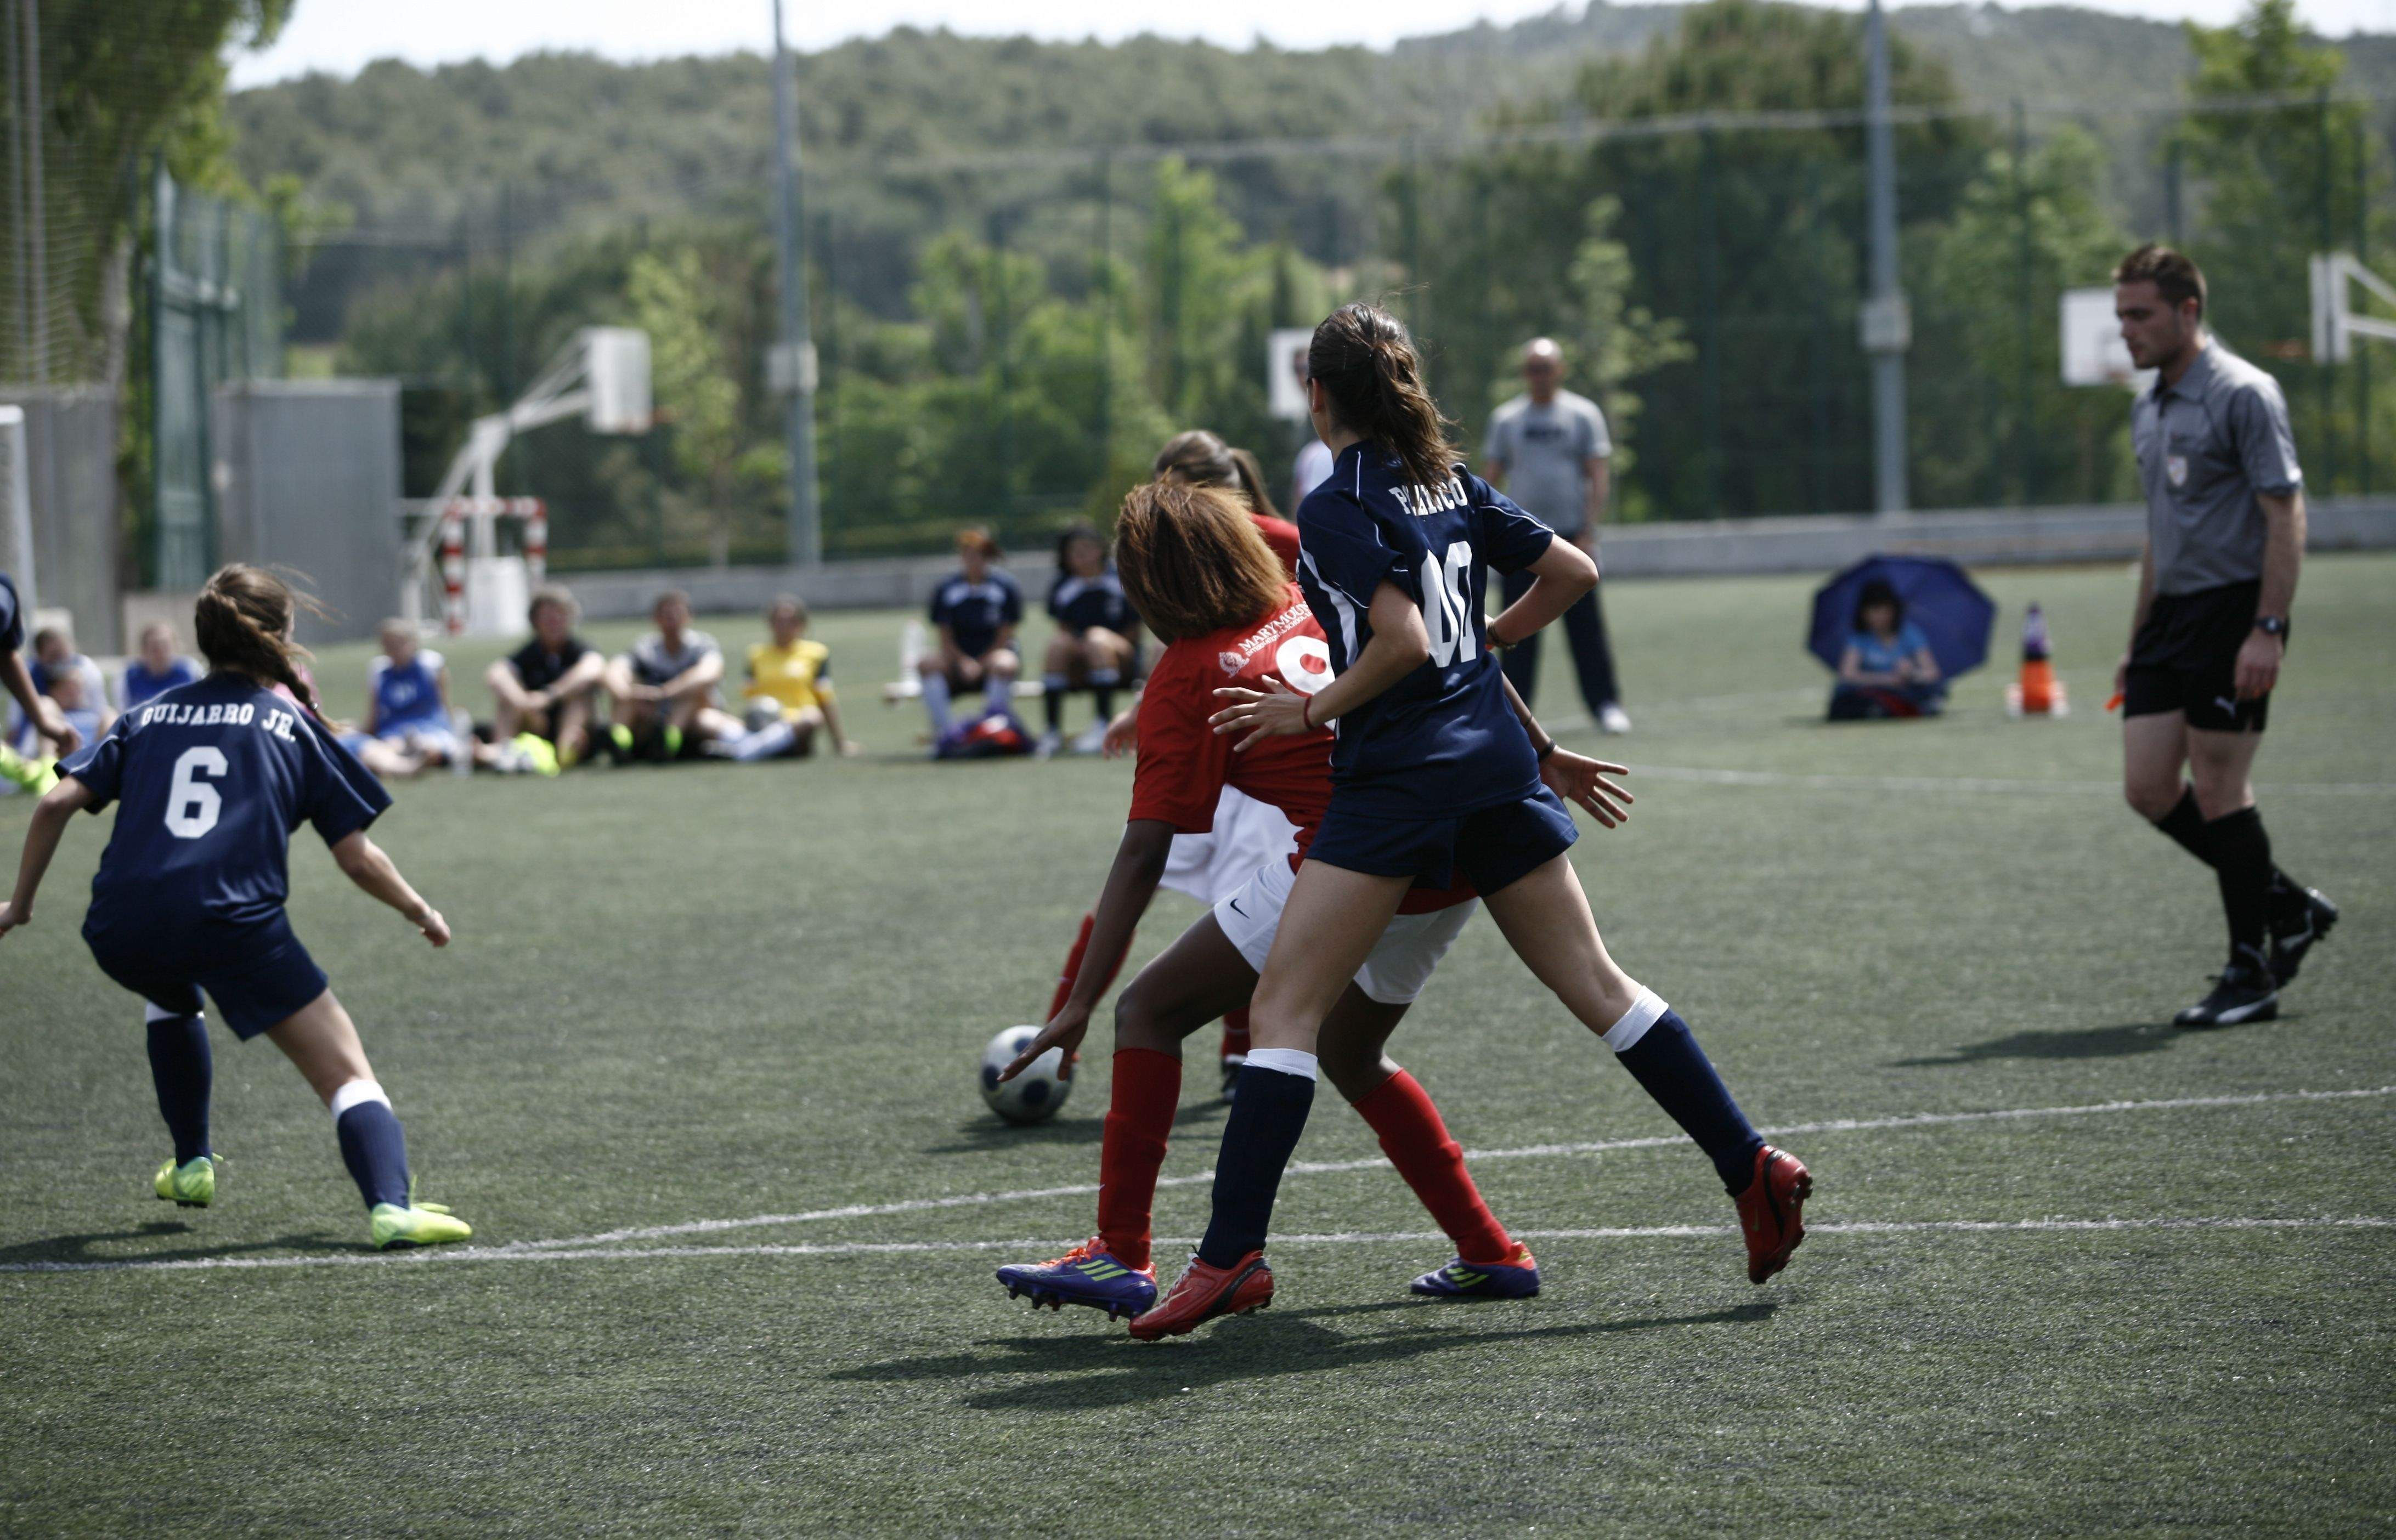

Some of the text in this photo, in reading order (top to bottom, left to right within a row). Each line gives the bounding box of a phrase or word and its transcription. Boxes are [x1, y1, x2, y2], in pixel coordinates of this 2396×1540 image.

[141, 703, 296, 742] GUIJARRO JR.
[165, 746, 228, 839] 6
